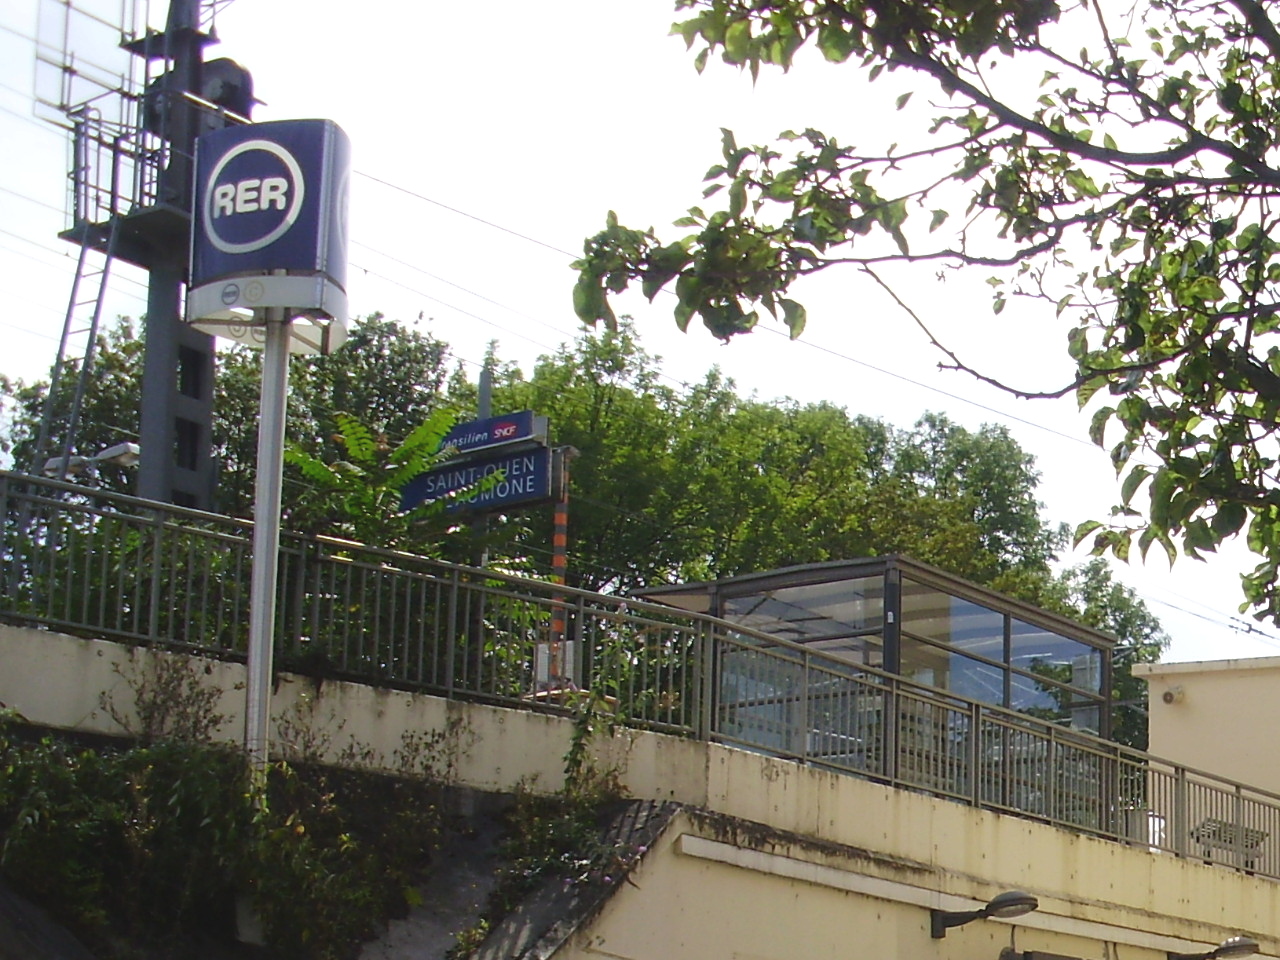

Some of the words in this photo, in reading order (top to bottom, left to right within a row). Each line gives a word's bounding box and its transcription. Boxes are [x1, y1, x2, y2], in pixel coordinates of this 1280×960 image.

[213, 177, 288, 219] RER
[440, 431, 489, 449] ransilien
[493, 425, 517, 439] SNCF
[426, 456, 536, 493] SAINT-OUEN
